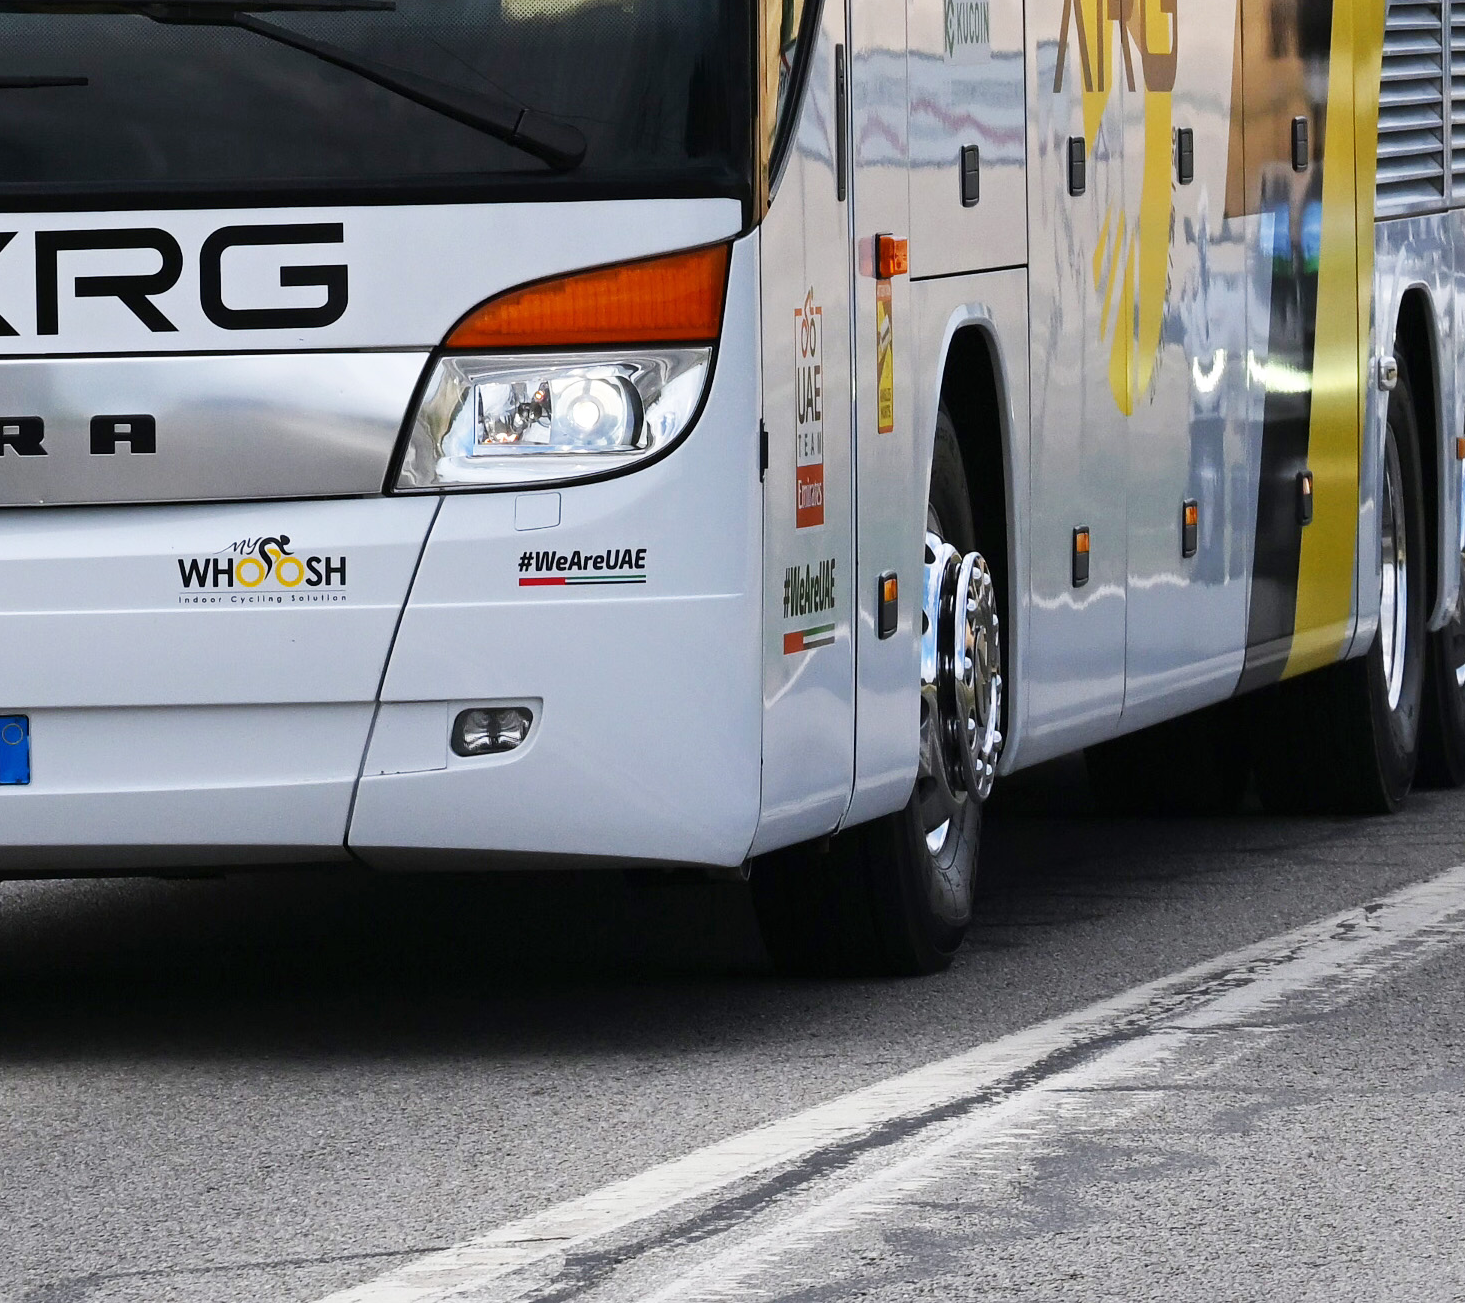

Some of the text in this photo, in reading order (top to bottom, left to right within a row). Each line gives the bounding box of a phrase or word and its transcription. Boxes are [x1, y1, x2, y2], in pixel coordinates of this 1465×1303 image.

[956, 2, 990, 45] KUCOIN
[797, 365, 821, 424] UAE
[798, 431, 822, 459] TEAM
[798, 478, 823, 511] Emirates
[177, 555, 347, 588] WHOOSH
[518, 548, 647, 573] #WeAreUAE
[178, 593, 347, 605] Indoor Cycling Solution
[783, 558, 836, 619] #WeAreUAE
